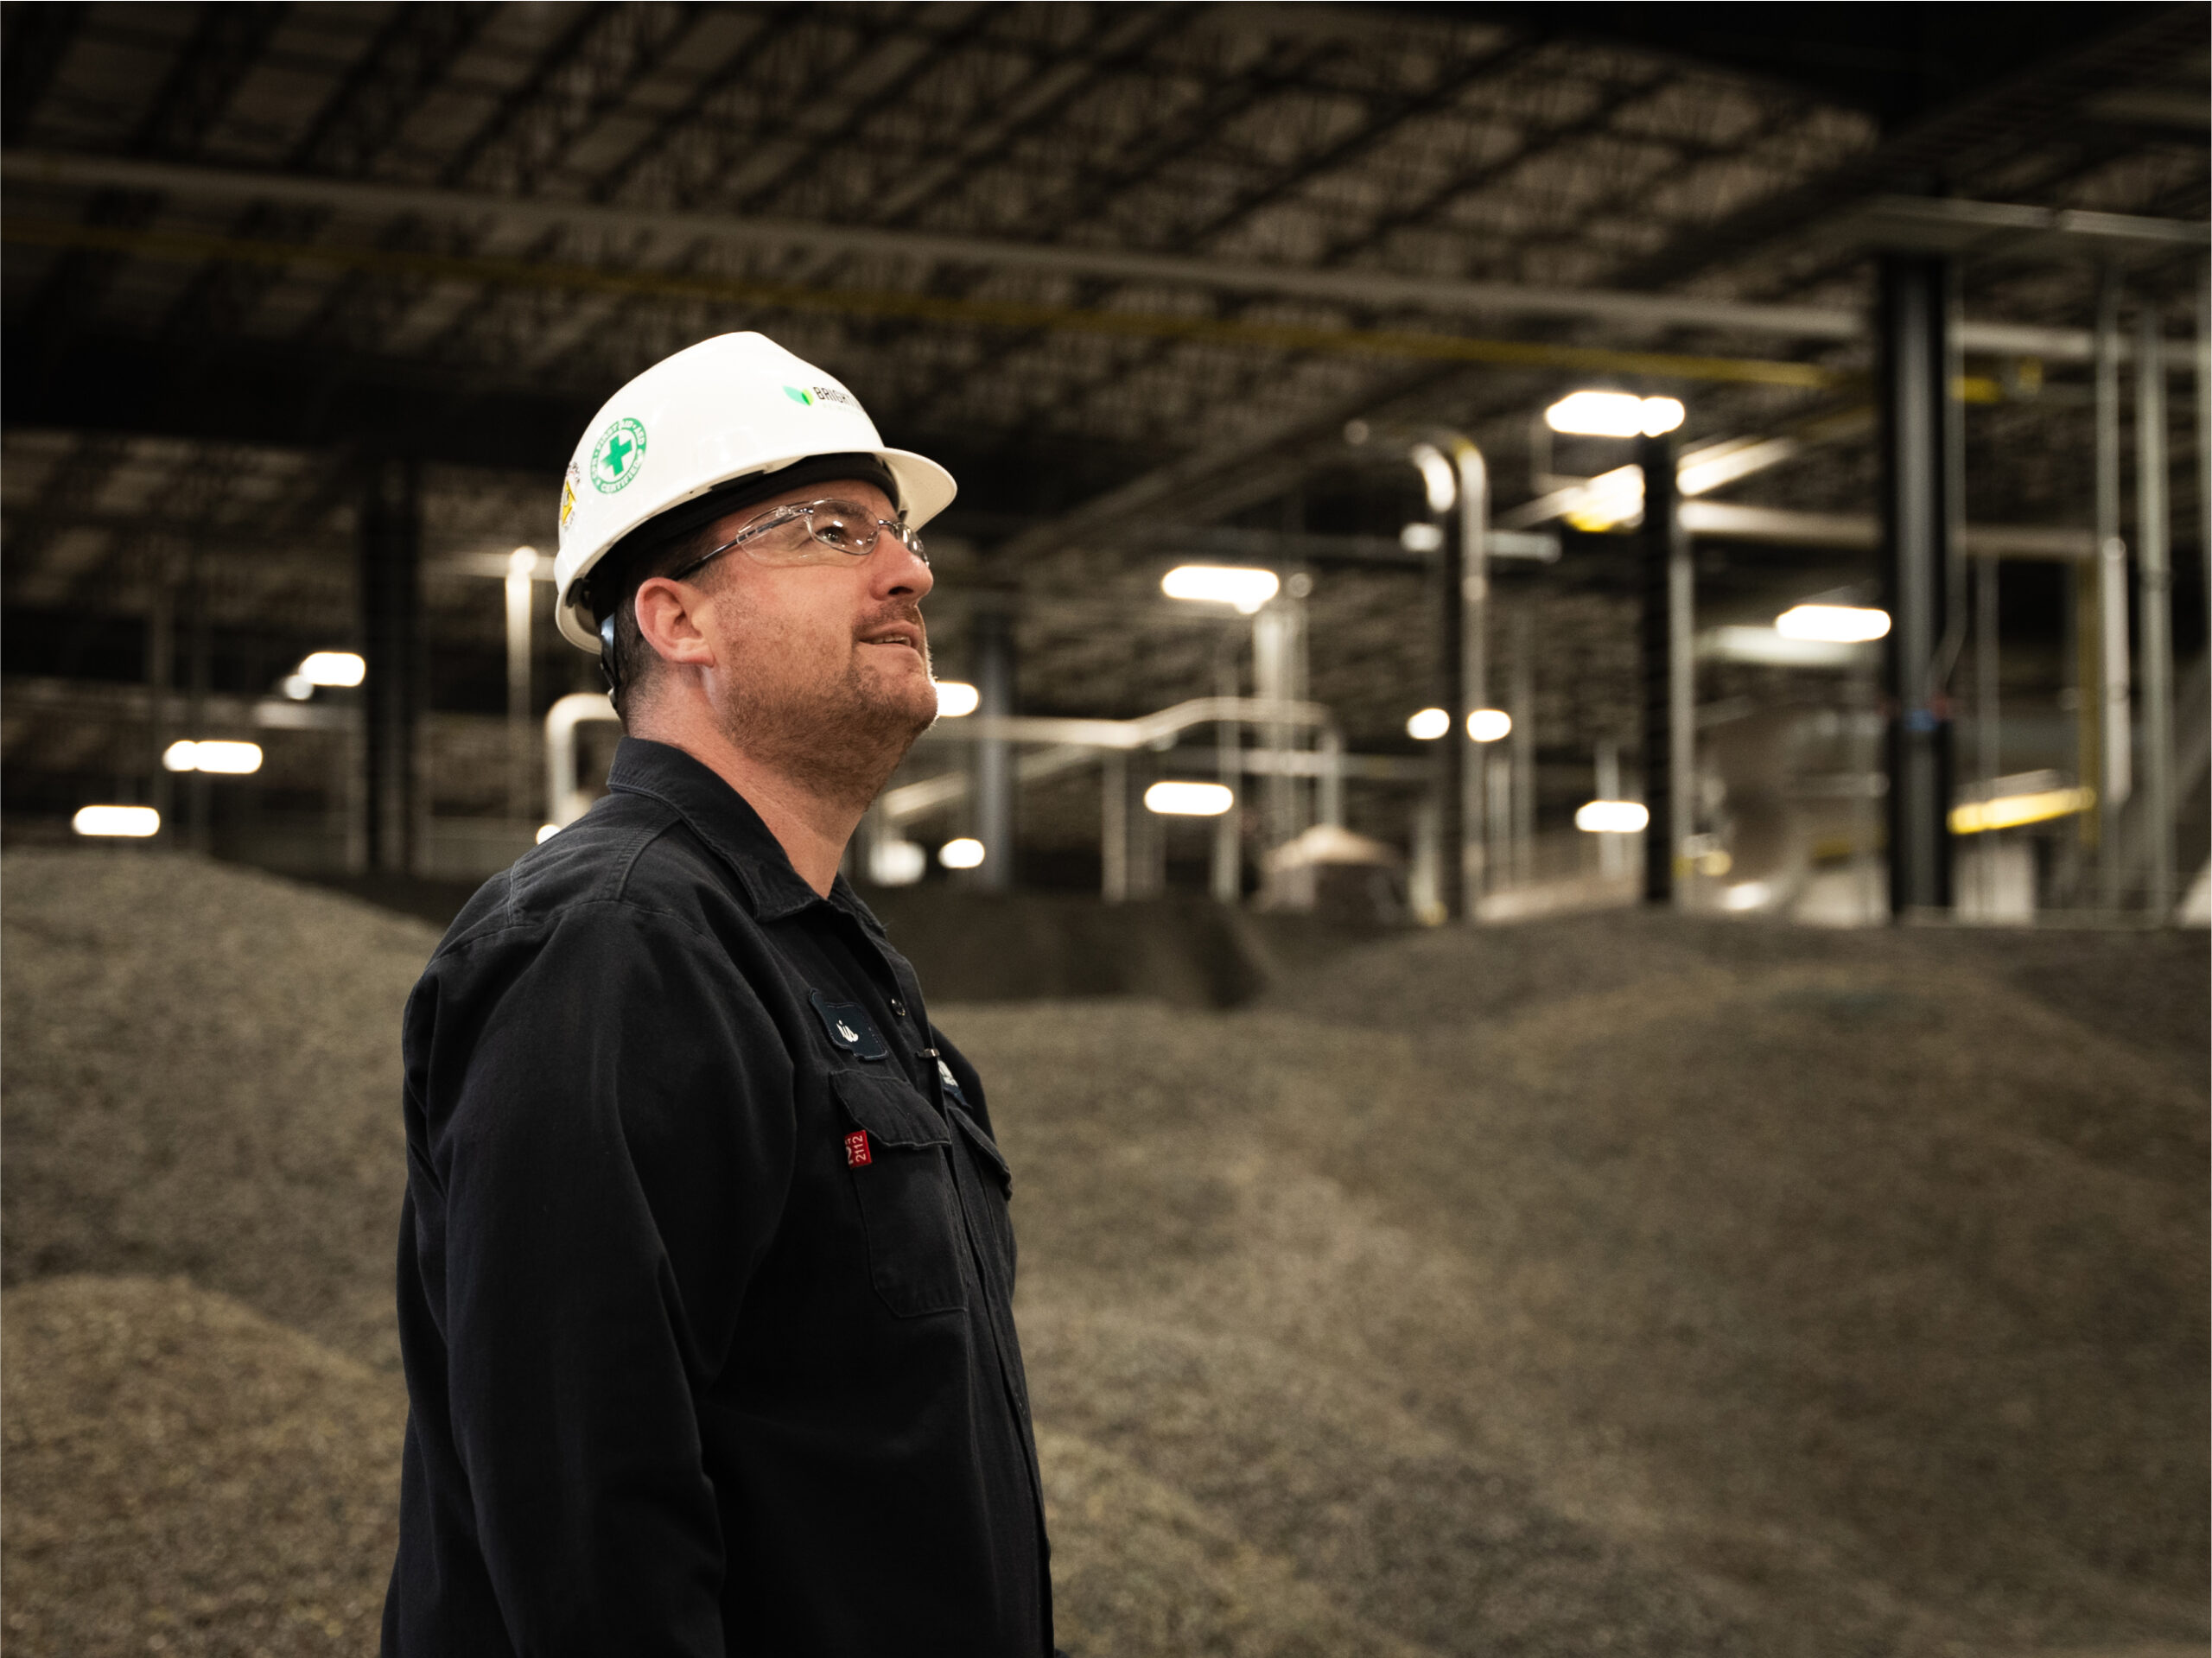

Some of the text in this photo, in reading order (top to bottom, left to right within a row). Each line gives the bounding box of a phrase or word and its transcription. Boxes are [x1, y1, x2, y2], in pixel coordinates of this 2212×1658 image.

[596, 424, 619, 451] FIRST
[601, 460, 641, 492] CERTIFIED
[852, 1135, 867, 1162] 2112
